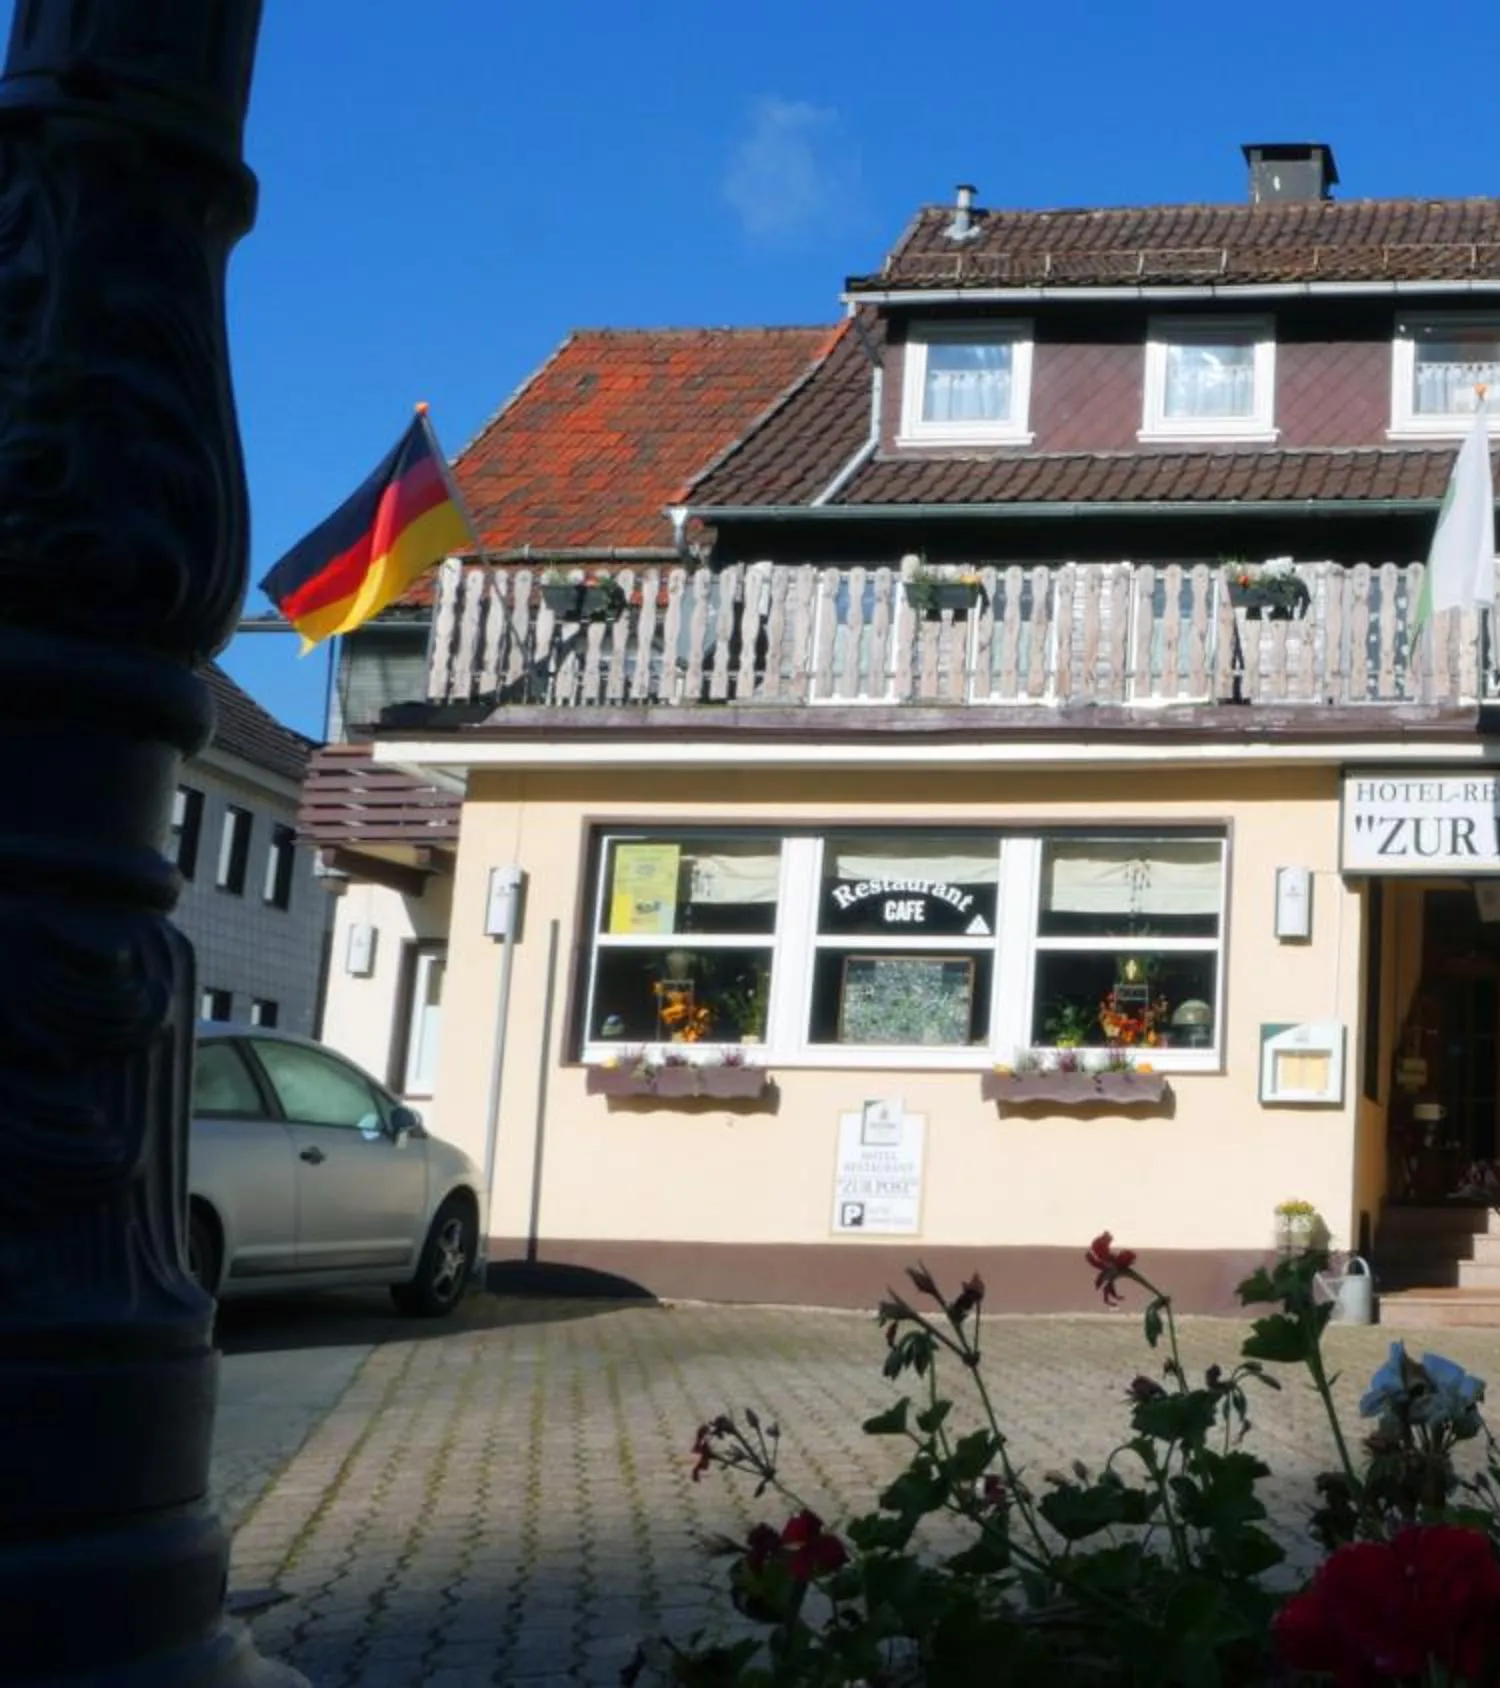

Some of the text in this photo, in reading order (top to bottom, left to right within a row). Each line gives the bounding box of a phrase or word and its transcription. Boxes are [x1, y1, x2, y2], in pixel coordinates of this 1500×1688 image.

[1354, 814, 1478, 857] "ZUR
[832, 876, 974, 913] Restaurant
[884, 899, 926, 922] CAFE
